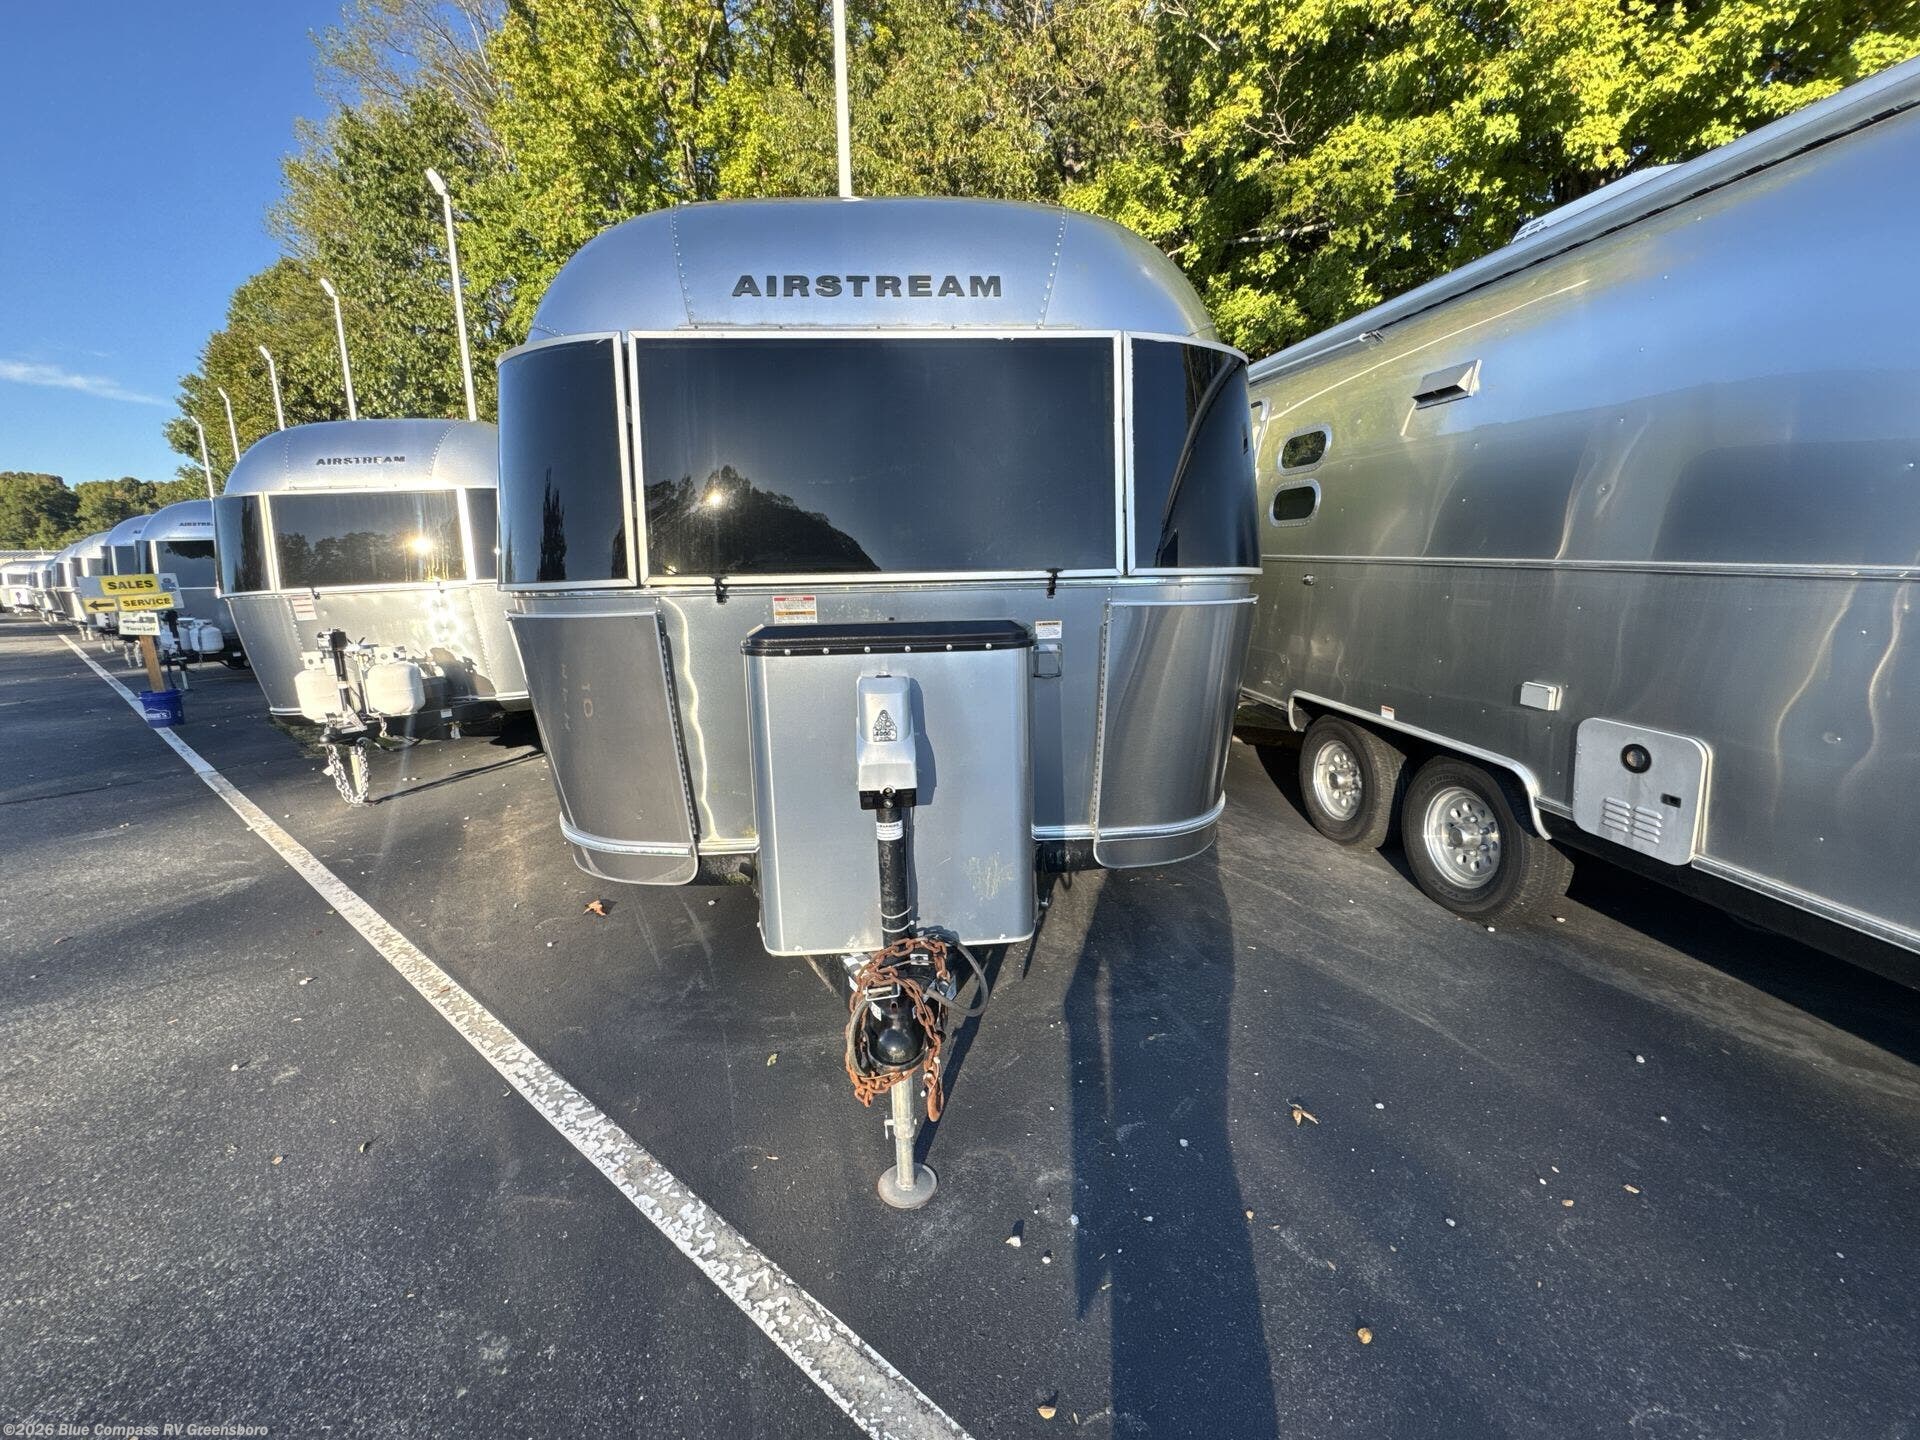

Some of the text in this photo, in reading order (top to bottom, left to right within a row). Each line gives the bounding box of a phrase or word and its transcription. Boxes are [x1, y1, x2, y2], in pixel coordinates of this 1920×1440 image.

[732, 275, 1002, 297] AIRSTREAM
[316, 455, 406, 465] AIRSTREAM
[107, 579, 154, 590] SALES
[122, 597, 171, 608] SERVICE
